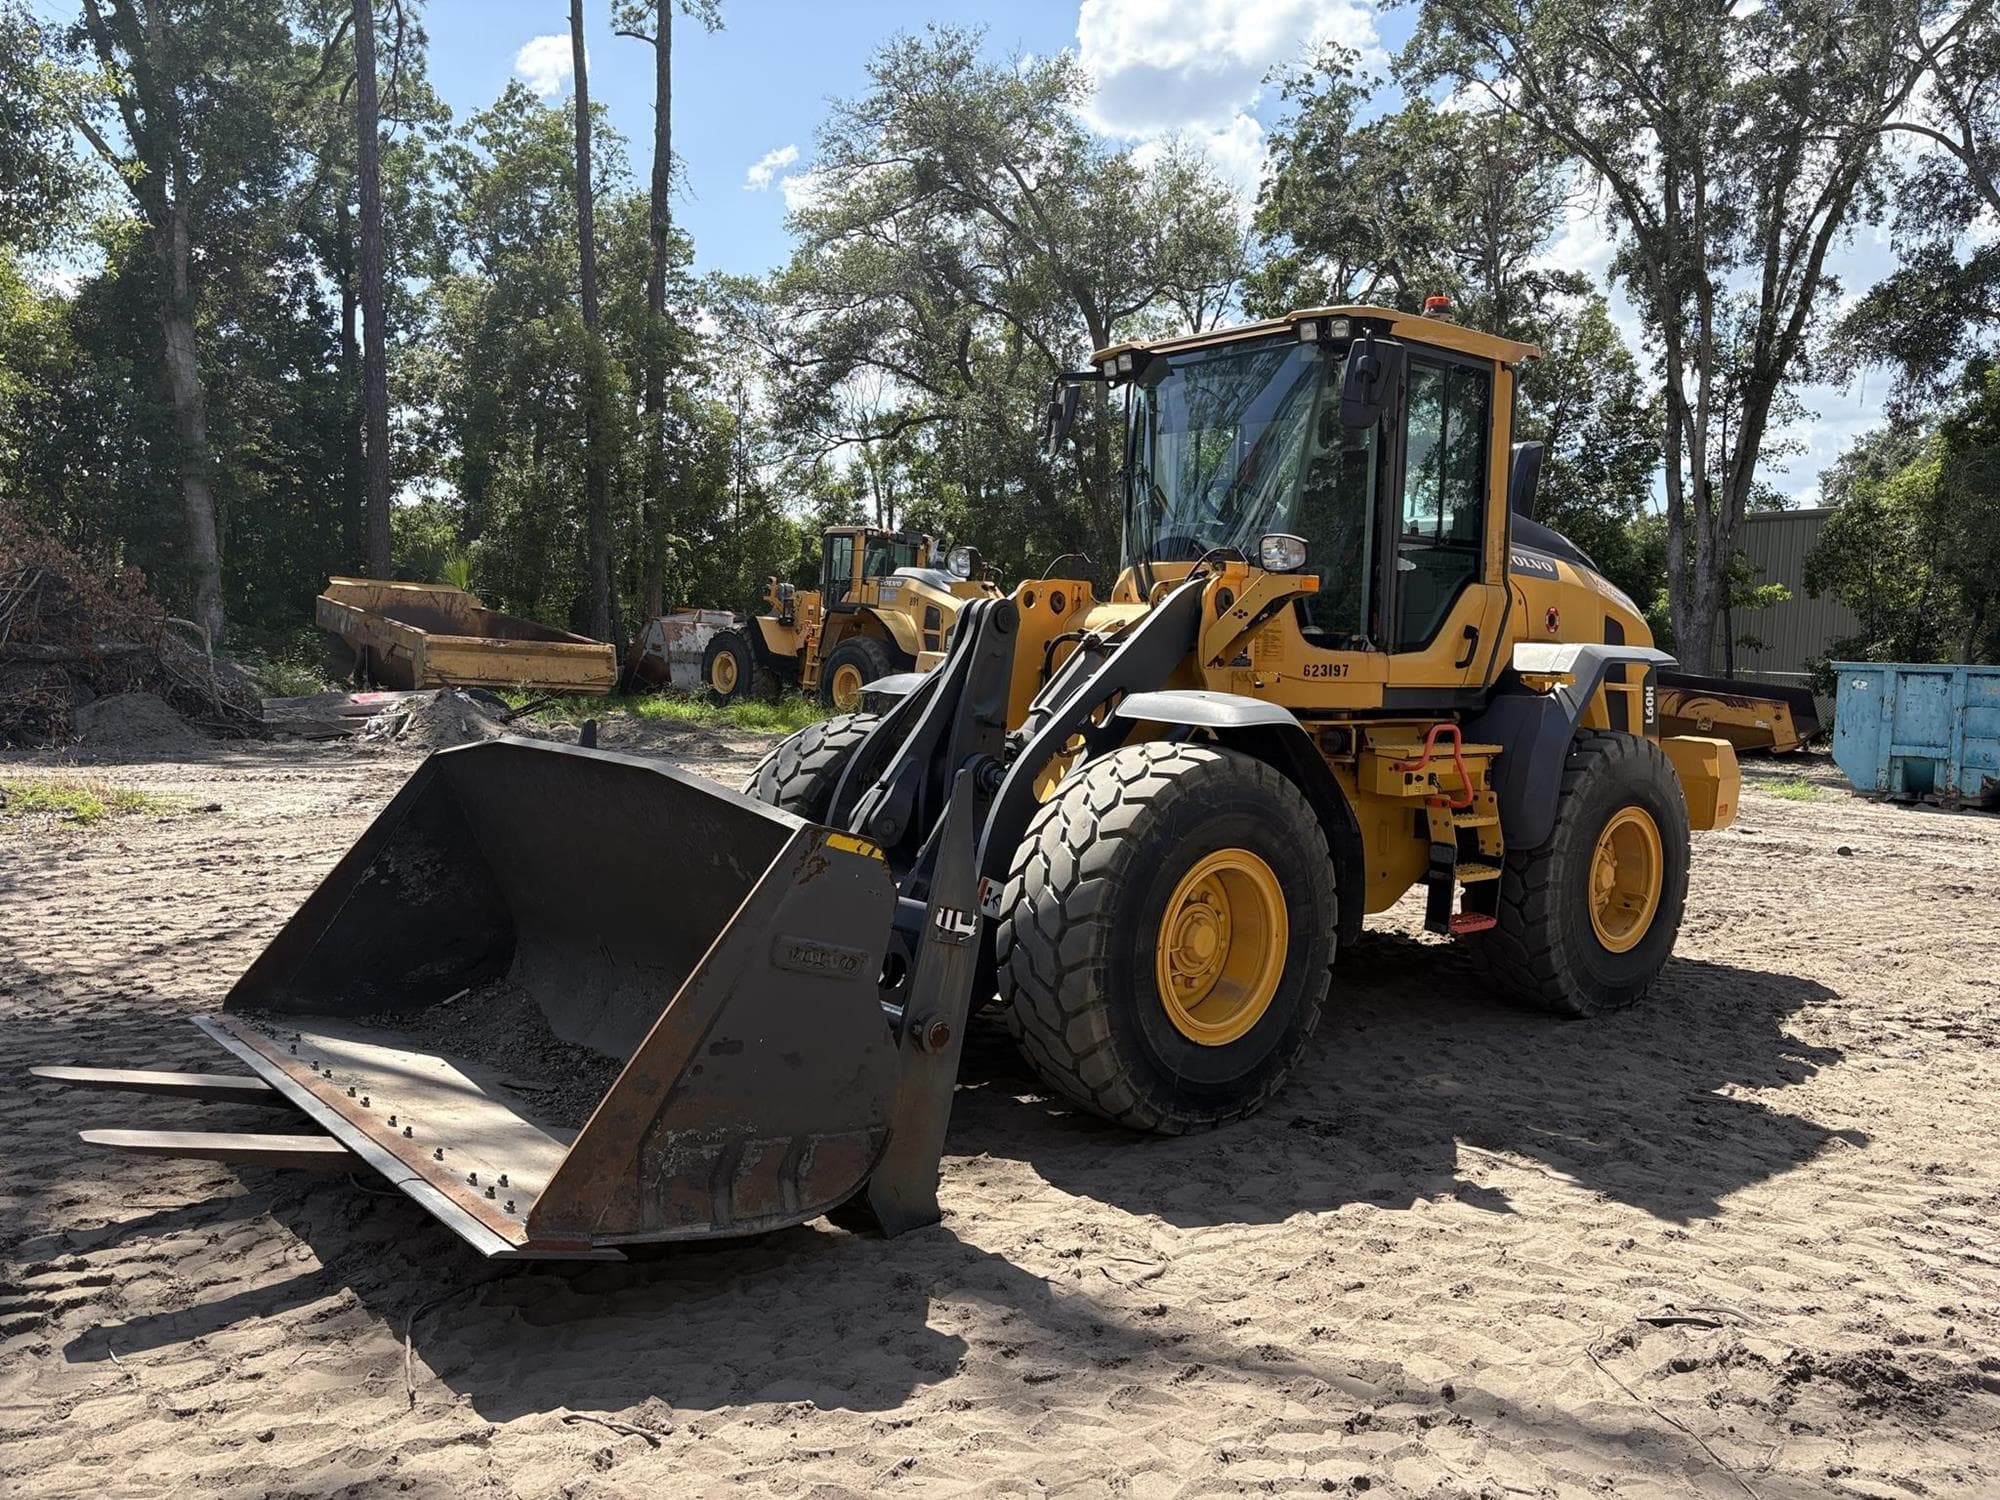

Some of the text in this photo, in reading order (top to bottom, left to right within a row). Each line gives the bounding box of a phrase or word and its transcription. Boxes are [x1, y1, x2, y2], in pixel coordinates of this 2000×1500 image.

[1510, 555, 1553, 573] OLVO
[1303, 664, 1349, 677] 623197
[1645, 686, 1654, 724] L60H
